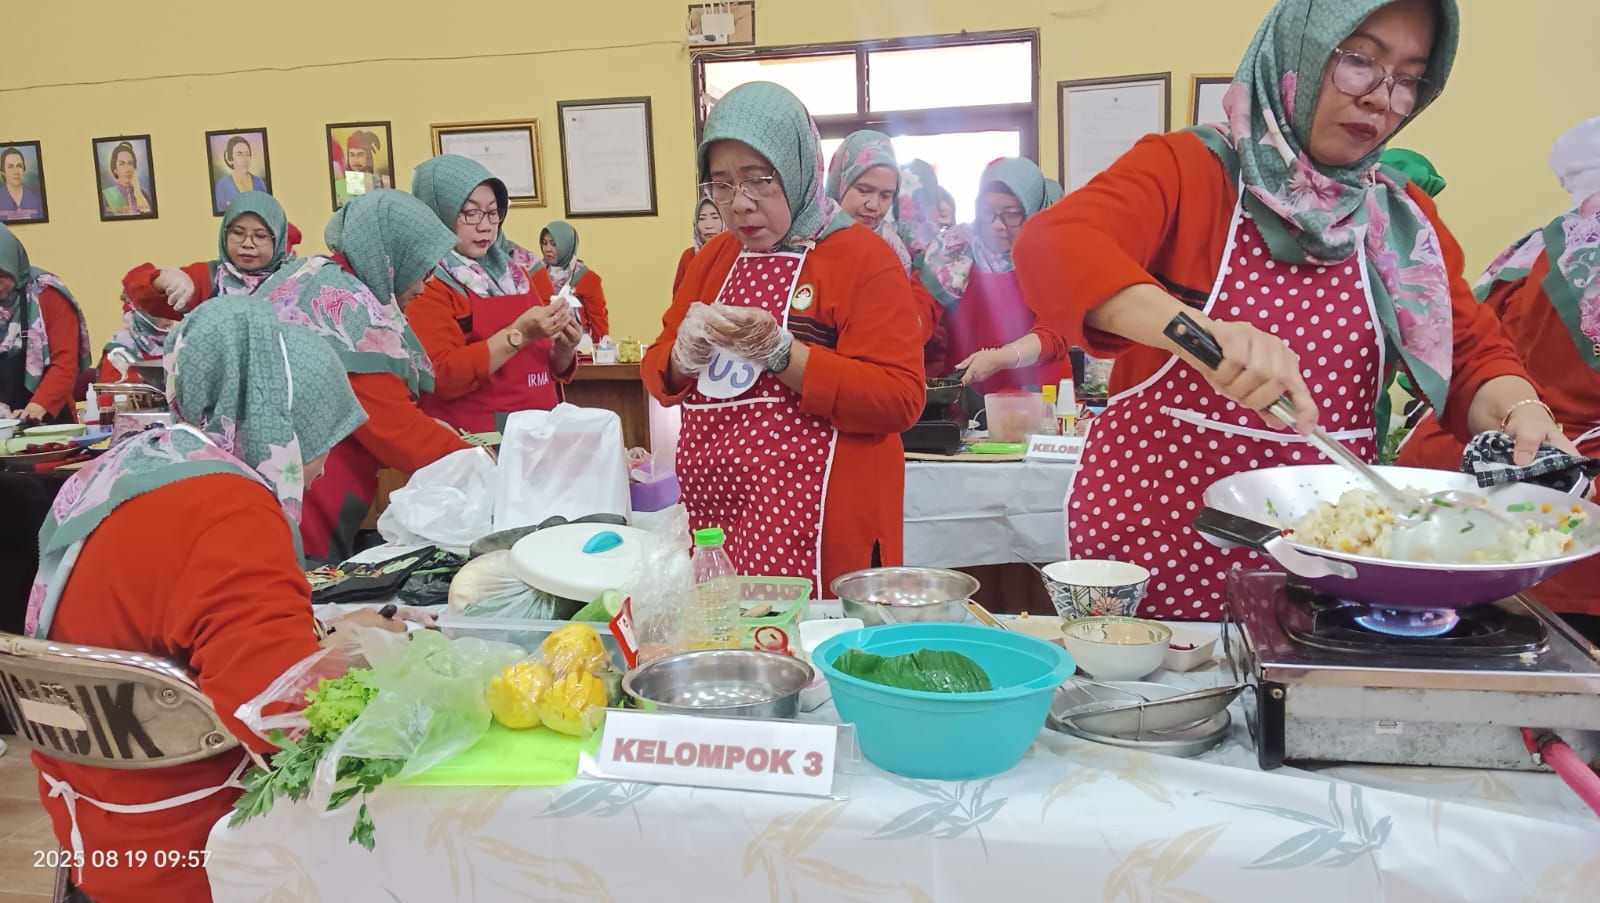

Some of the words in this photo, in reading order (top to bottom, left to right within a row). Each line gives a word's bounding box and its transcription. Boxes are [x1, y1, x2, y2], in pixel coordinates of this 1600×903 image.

[527, 371, 549, 388] IRMA
[612, 737, 797, 775] KELOMPOK
[803, 751, 824, 777] 3
